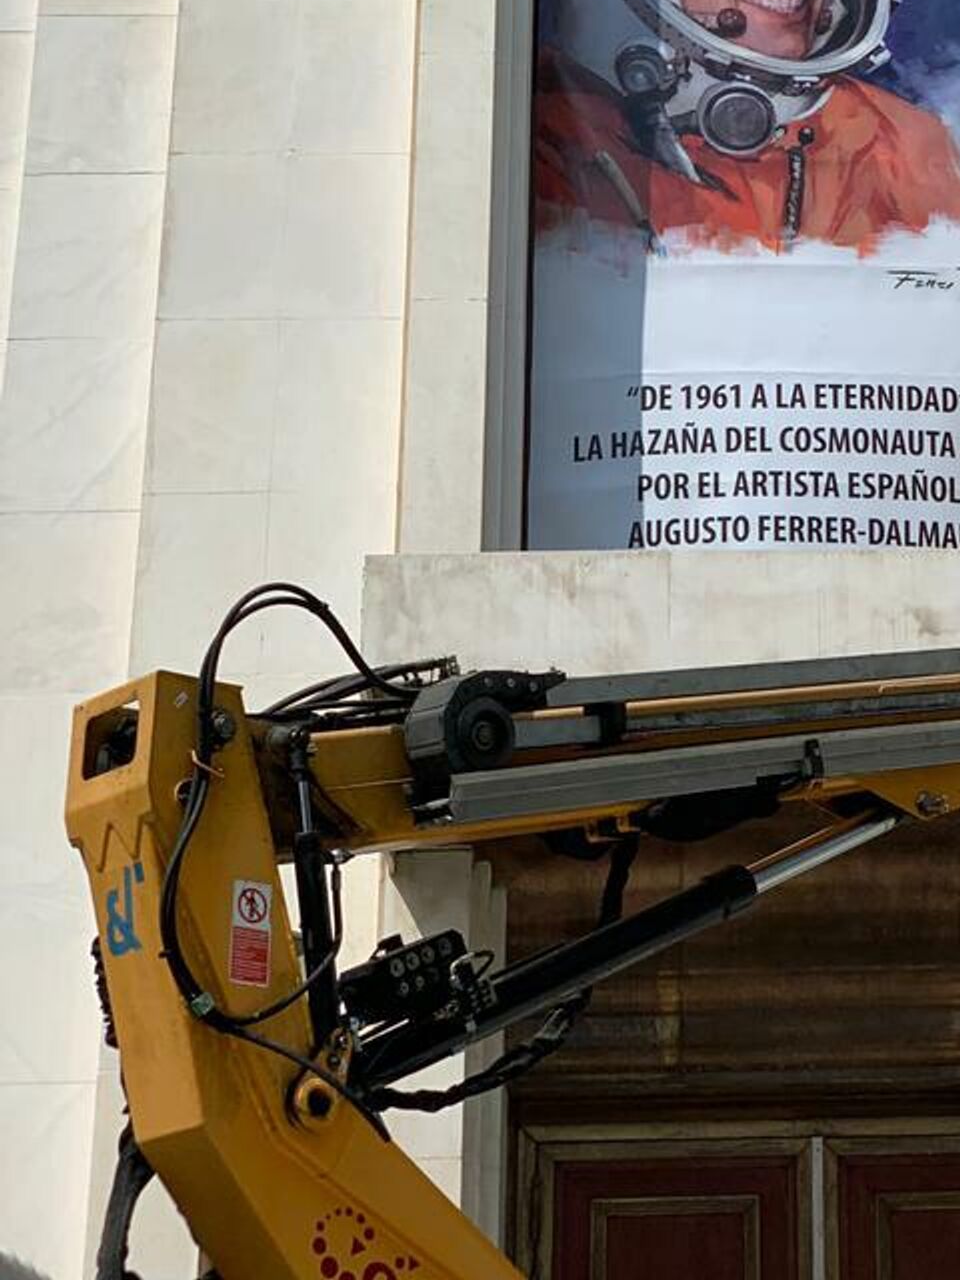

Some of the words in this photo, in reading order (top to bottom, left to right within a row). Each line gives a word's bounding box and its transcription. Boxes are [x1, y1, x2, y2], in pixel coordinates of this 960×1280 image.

[680, 384, 741, 409] 1961
[751, 384, 768, 408] A
[776, 384, 806, 408] LA
[573, 434, 603, 462] LA
[611, 422, 717, 458] HAZAÑA
[725, 427, 772, 453] DEL
[780, 427, 955, 458] COSMONAUTA
[638, 473, 689, 501] POR
[698, 472, 725, 498] EL
[733, 471, 839, 497] ARTISTA
[848, 469, 960, 504] ESPAÑOL
[628, 516, 749, 549] AUGUSTO
